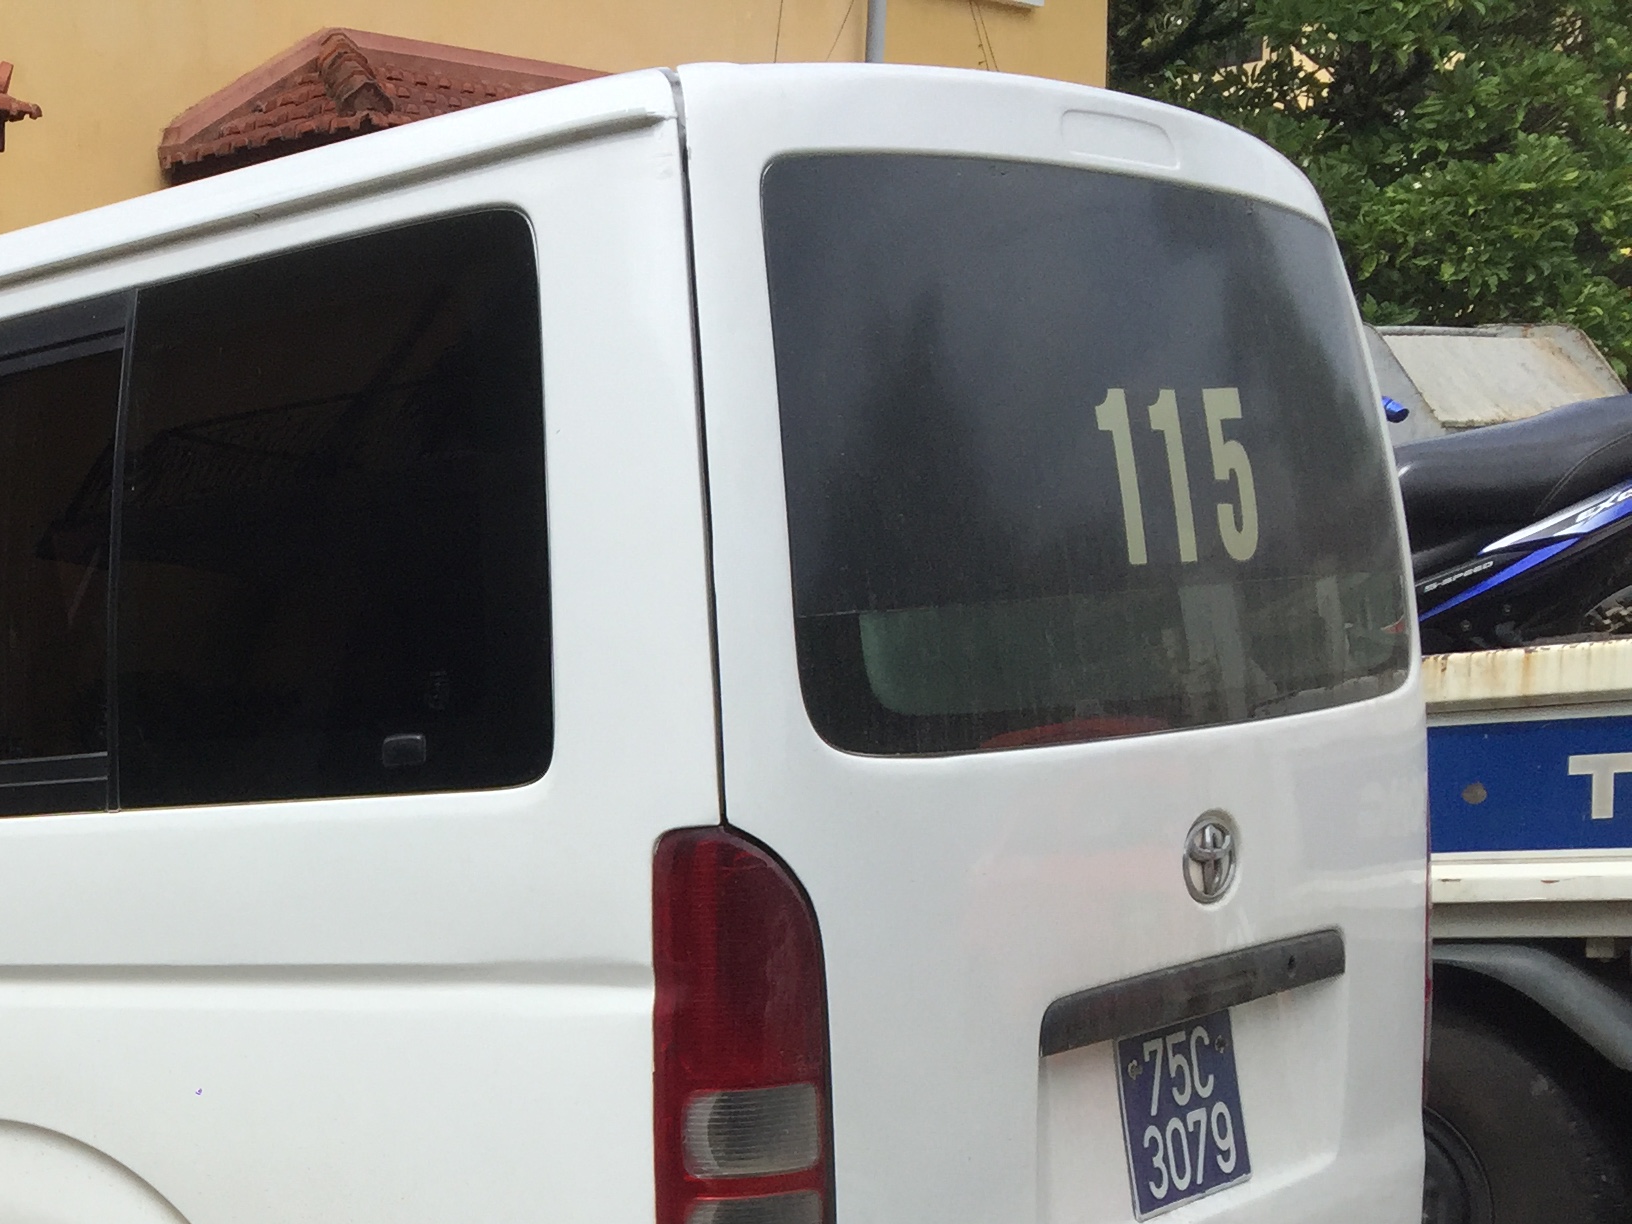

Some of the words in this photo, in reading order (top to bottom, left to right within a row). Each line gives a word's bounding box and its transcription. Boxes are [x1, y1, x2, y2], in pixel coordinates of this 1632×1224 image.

[1095, 387, 1258, 565] 115
[1568, 752, 1632, 819] T
[1142, 1025, 1214, 1116] 75C
[1143, 1101, 1237, 1199] 3079
